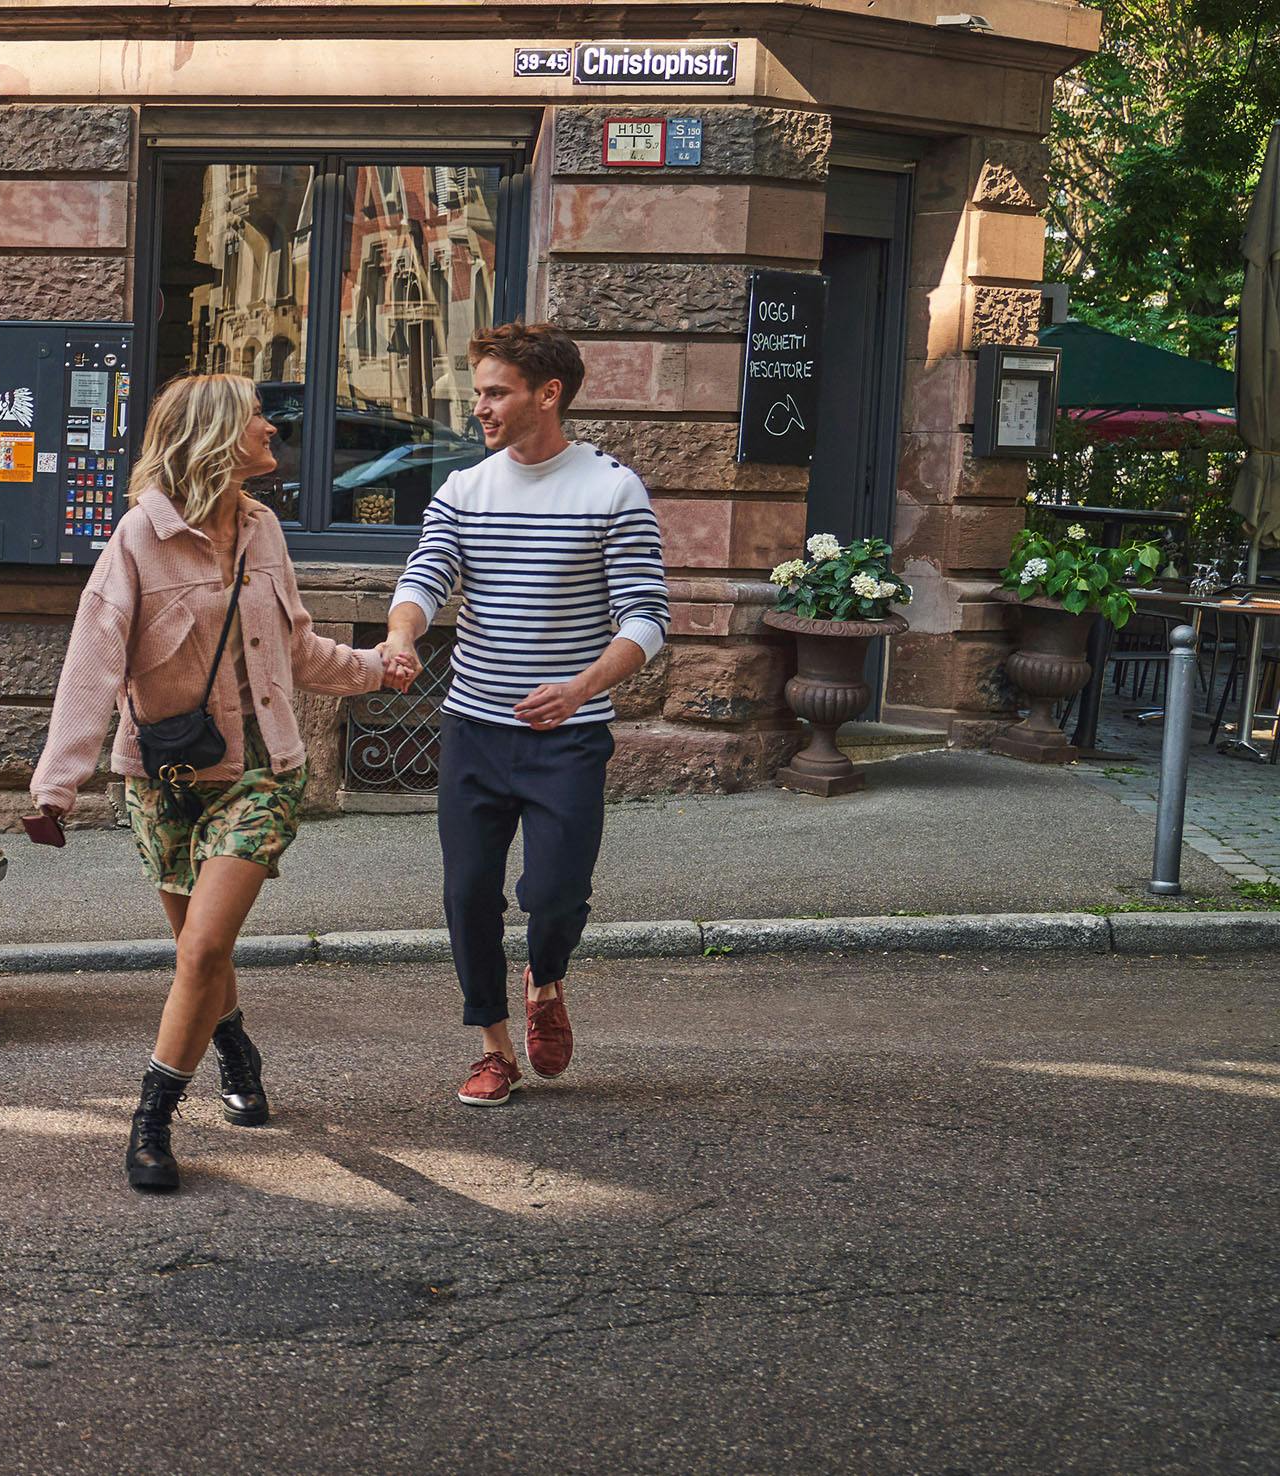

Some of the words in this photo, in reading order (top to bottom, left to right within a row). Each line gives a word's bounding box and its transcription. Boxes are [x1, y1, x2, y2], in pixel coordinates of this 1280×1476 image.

[517, 53, 568, 71] 39-45
[583, 47, 729, 80] Christophstr.
[758, 292, 796, 322] OGGI
[752, 326, 807, 351] SPAGHETTI
[749, 360, 814, 379] PESCATORE
